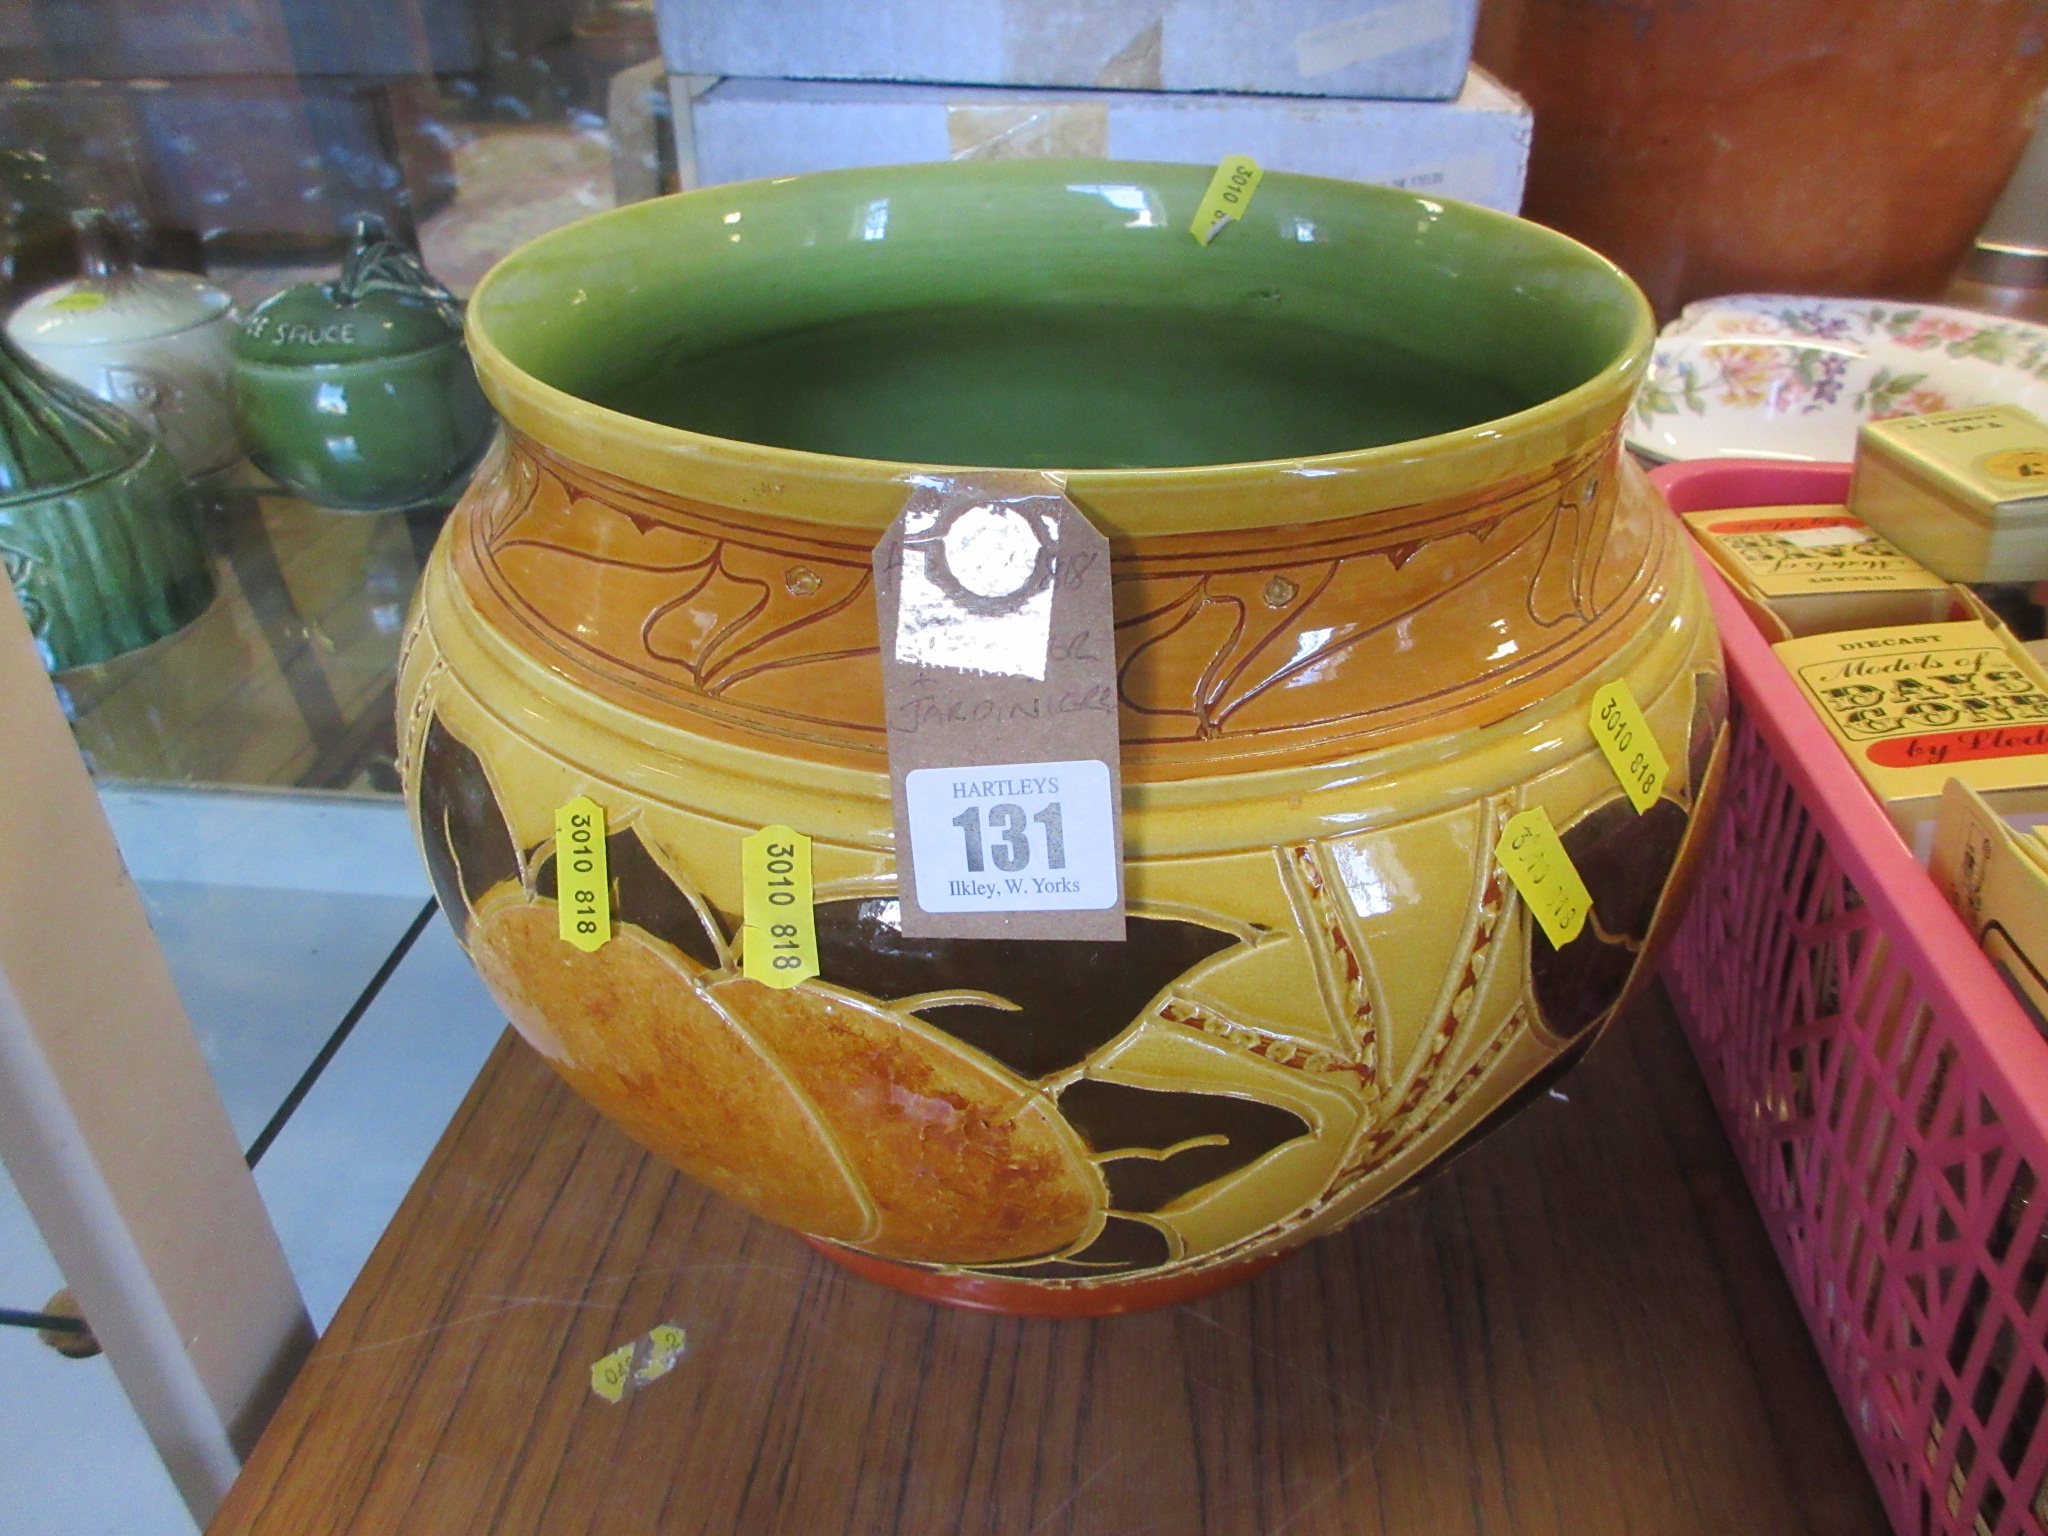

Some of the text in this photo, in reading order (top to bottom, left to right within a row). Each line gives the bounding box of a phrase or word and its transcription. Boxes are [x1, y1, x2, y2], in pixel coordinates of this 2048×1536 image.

[1222, 165, 1254, 204] 3010
[272, 322, 355, 347] SAUCE
[1838, 634, 1942, 651] DIECAST
[1820, 651, 1990, 682] Models of
[1821, 670, 2035, 711] DAYS
[1600, 697, 1656, 795] 3010 818
[1906, 728, 2048, 764] by Lled
[952, 777, 1060, 798] HARTLEYS
[952, 802, 1066, 873] 131
[571, 814, 597, 934] 3010 818
[949, 876, 1080, 899] Ilkley, W. Yorks
[766, 843, 802, 971] 3010 818
